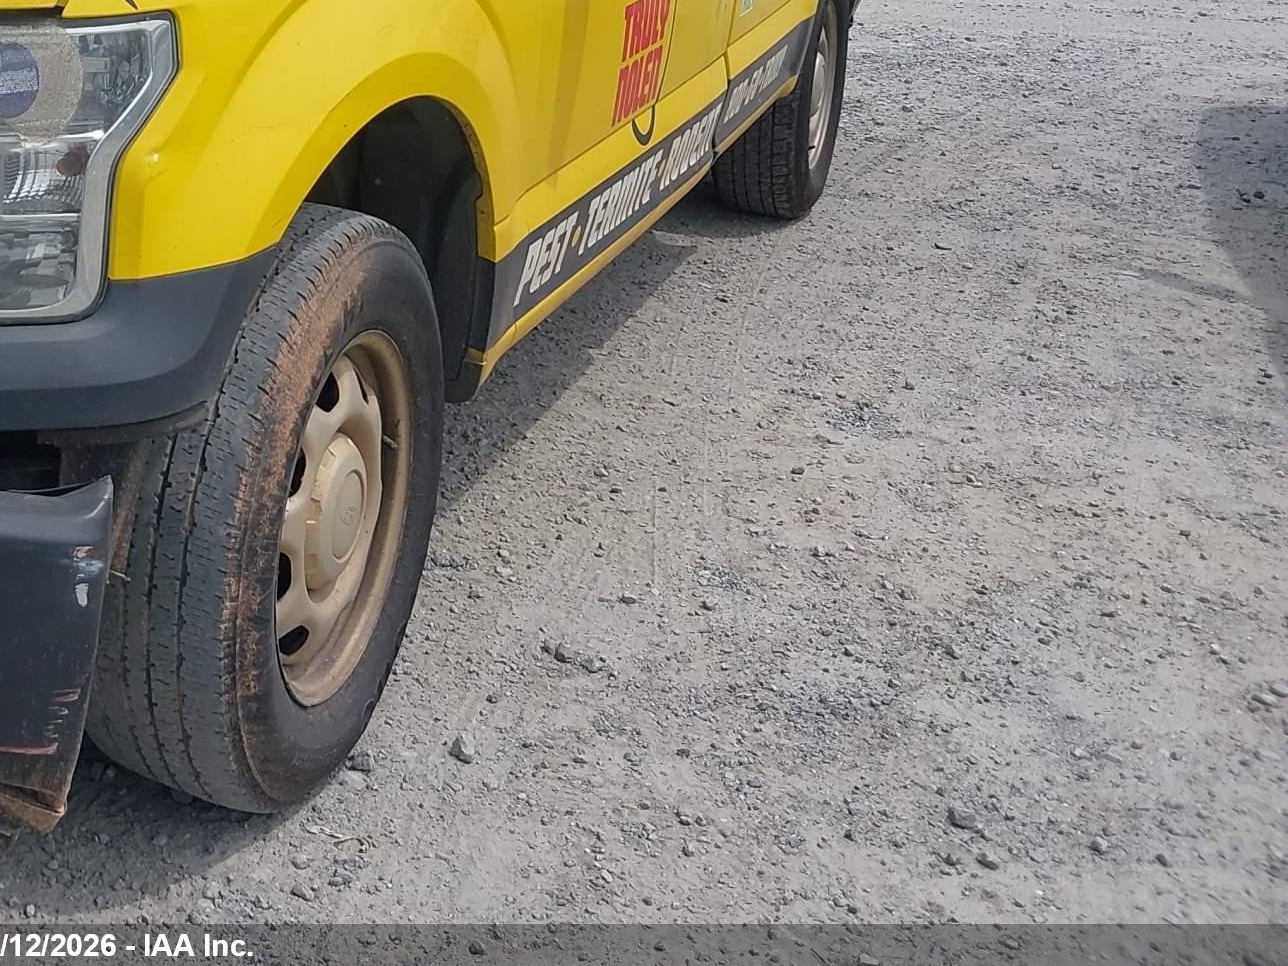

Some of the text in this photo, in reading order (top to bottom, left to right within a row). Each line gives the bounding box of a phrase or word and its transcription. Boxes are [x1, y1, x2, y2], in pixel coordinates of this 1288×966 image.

[611, 44, 663, 127] NOLEN
[513, 210, 580, 307] PEST
[578, 148, 664, 256] TERMITE
[659, 102, 722, 191] RODENT
